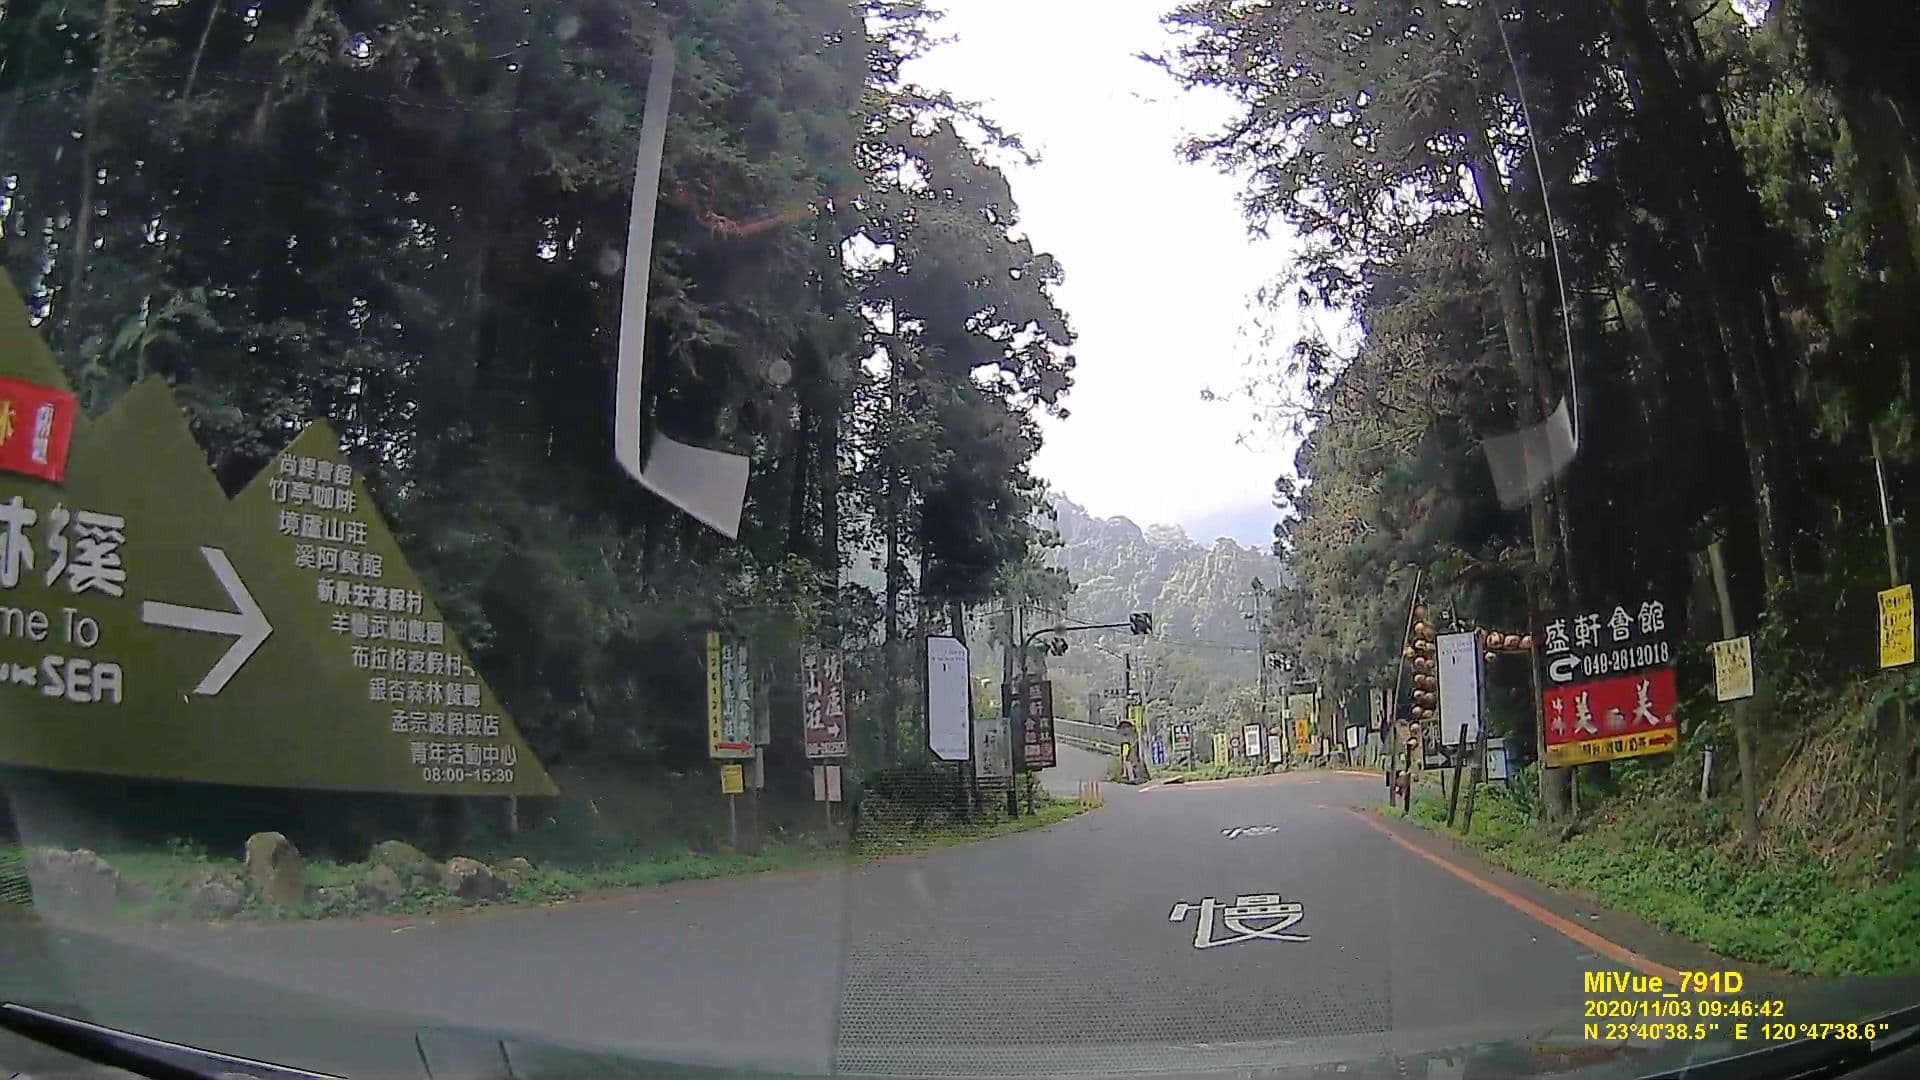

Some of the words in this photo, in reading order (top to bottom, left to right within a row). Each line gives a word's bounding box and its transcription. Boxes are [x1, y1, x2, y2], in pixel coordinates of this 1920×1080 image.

[63, 607, 99, 648] To
[1545, 600, 1665, 655] 盛軒會館
[411, 741, 518, 767] 青年活動中心
[1169, 893, 1312, 949] 慢
